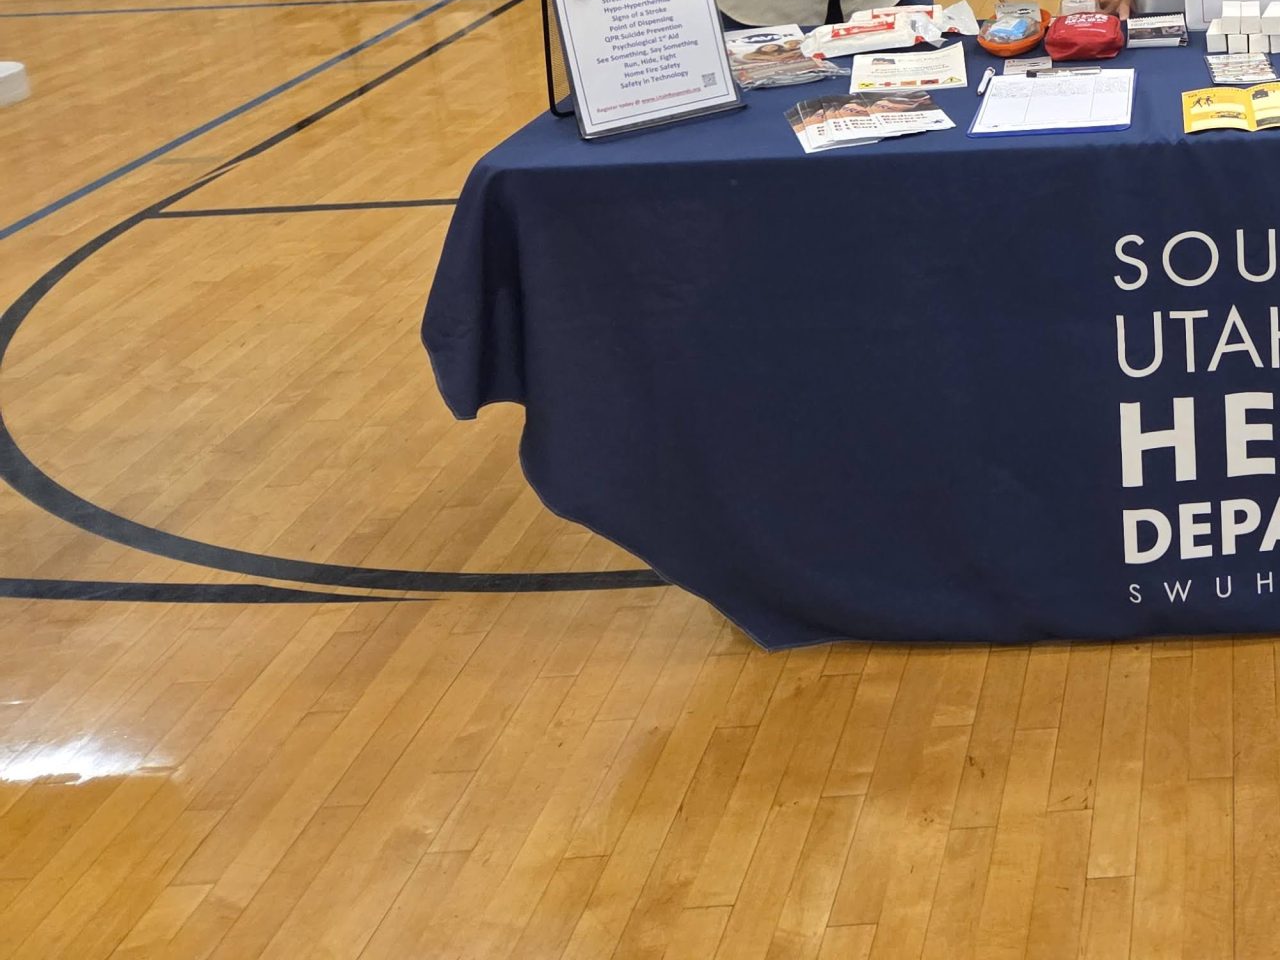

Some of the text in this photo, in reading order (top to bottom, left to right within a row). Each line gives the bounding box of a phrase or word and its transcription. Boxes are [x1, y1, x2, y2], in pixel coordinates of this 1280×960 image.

[611, 14, 630, 22] Signs
[644, 6, 668, 16] Stroke
[609, 23, 628, 32] Point
[638, 15, 674, 27] Dispensing
[604, 23, 683, 43] QPR Suicide Prevention
[612, 36, 658, 51] Psychological
[668, 32, 680, 41] Aid
[596, 39, 699, 65] See Something, Say Something
[624, 53, 676, 69] Run, Hide, Fight
[624, 62, 681, 78] Home Fire Safety
[620, 70, 689, 89] Safety in Technology
